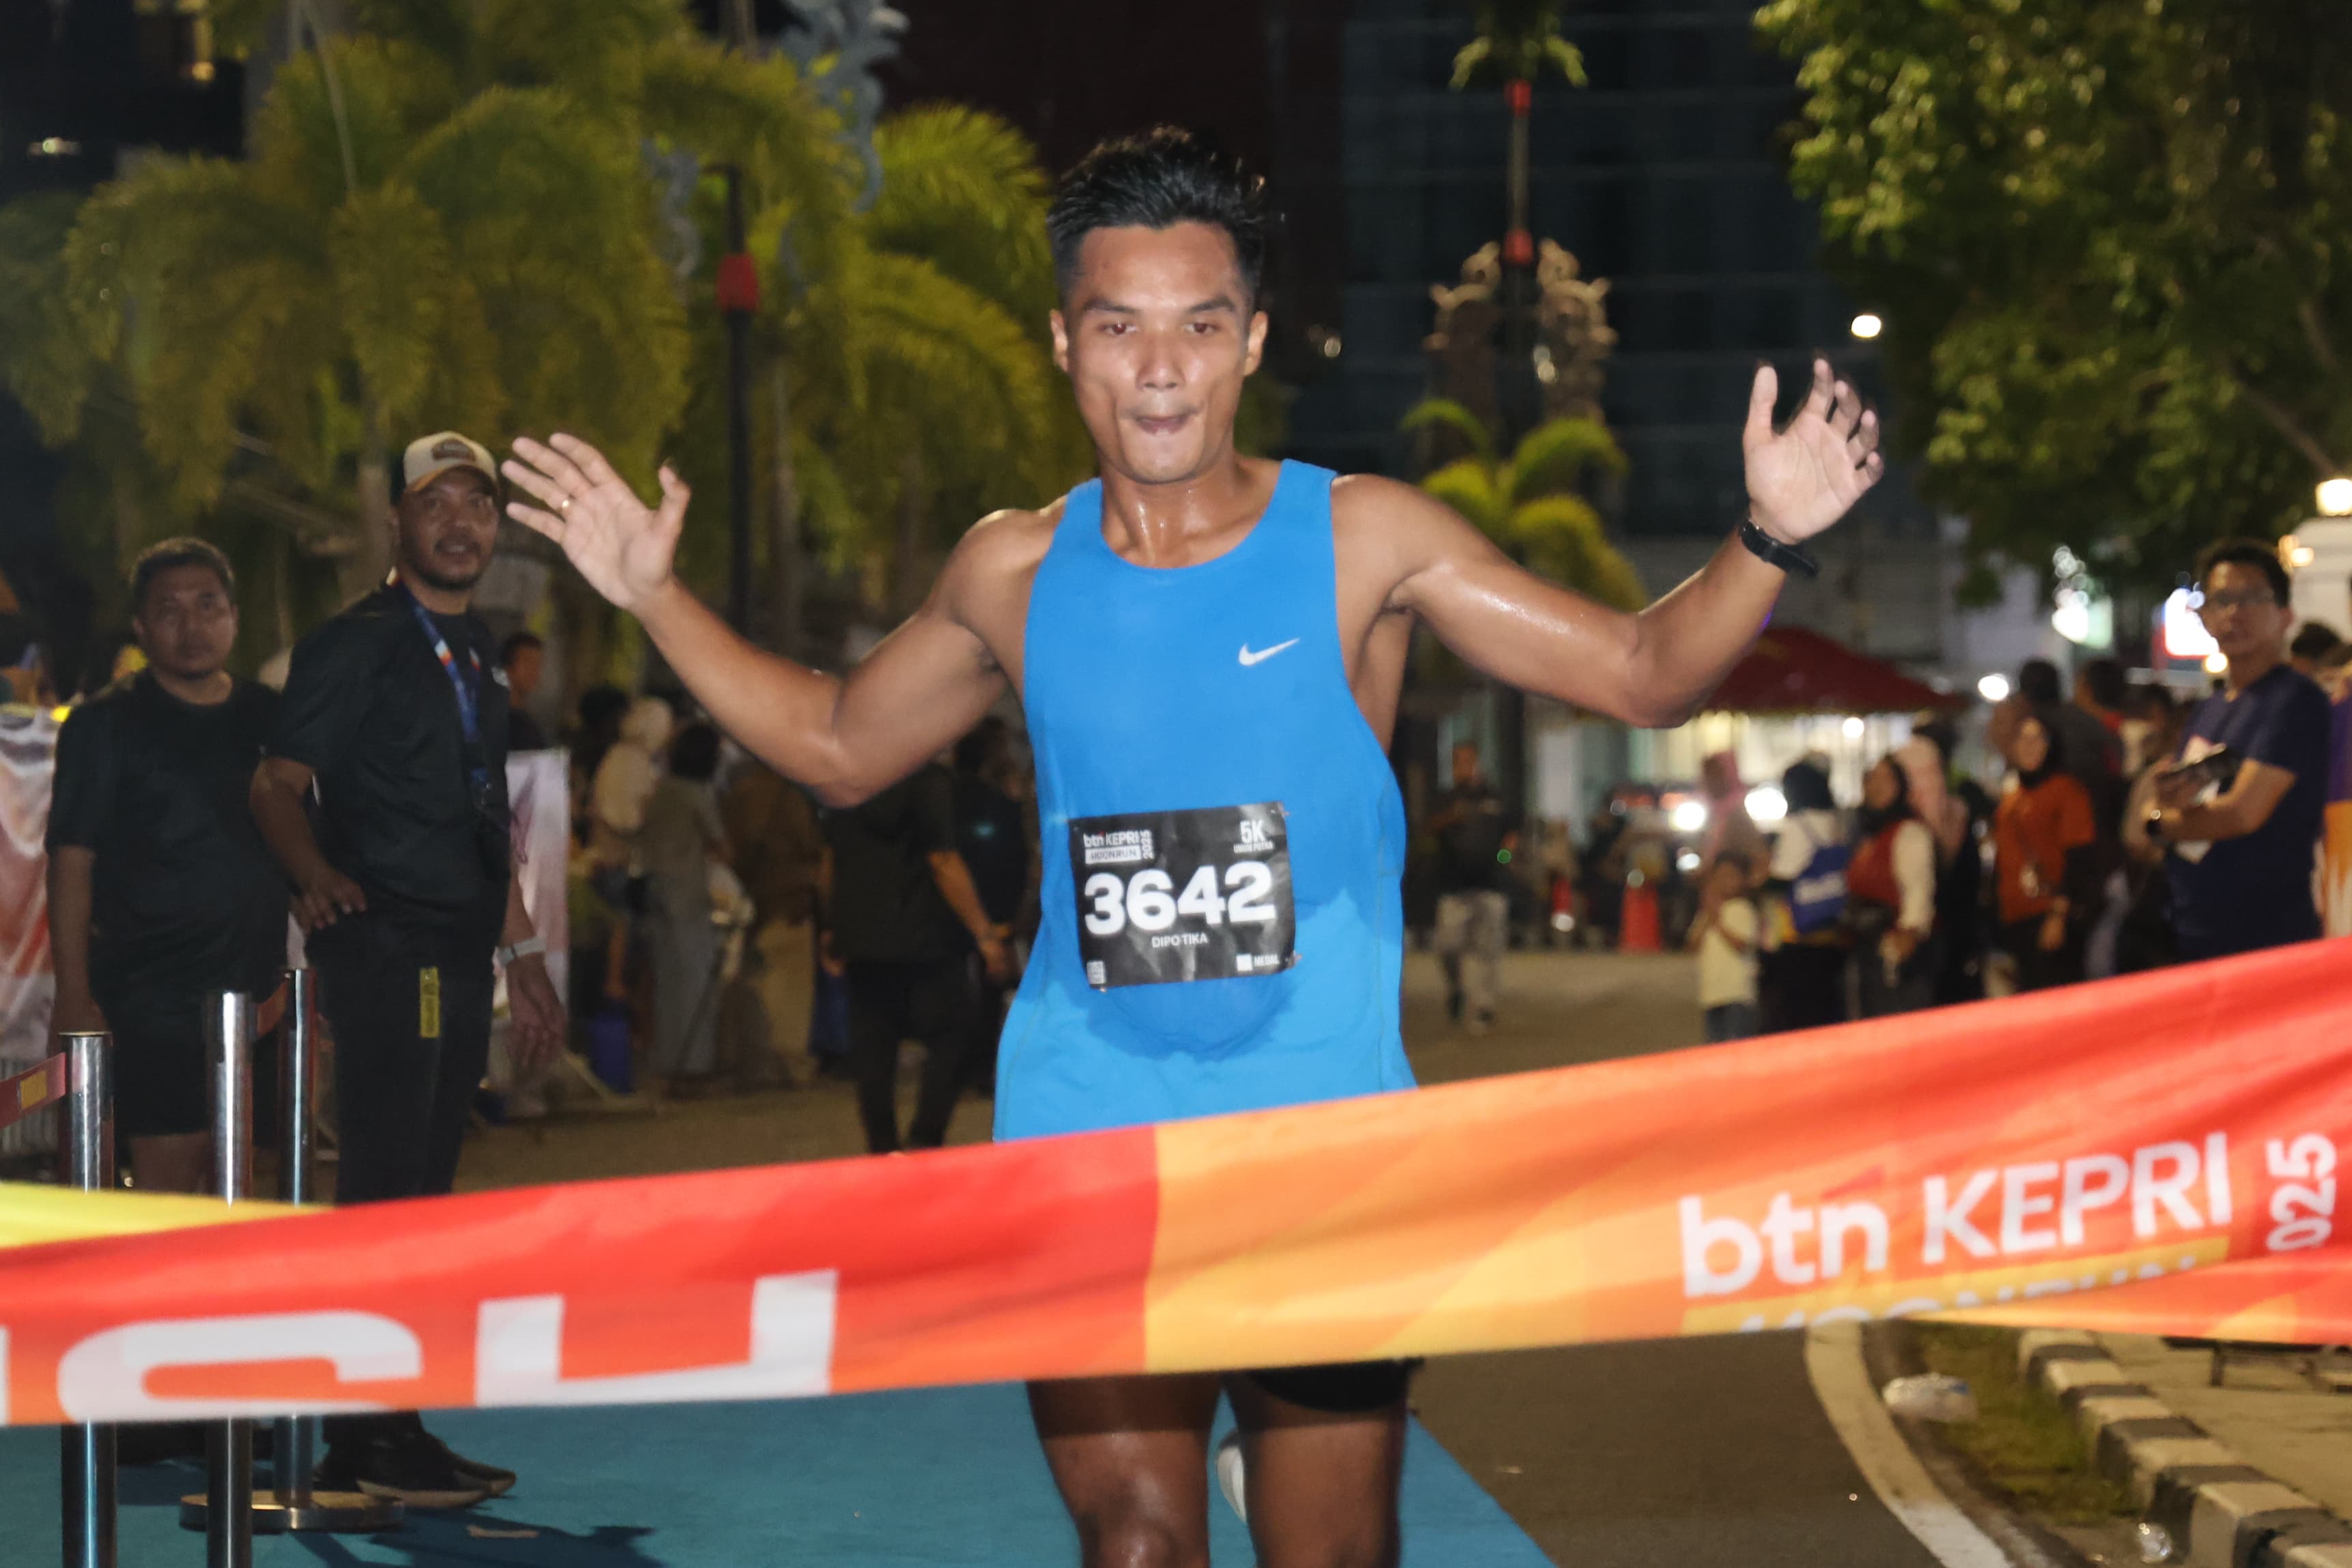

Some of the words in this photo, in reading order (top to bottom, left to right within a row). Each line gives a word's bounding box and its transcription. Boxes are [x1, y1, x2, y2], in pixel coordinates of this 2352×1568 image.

[1106, 830, 1140, 845] KEPRI
[1240, 820, 1265, 843] 5K
[1084, 860, 1276, 936] 3642
[1151, 935, 1179, 948] DIPO
[1181, 932, 1208, 945] TIKA
[1679, 1192, 1889, 1297] btn
[1922, 1132, 2232, 1265] KEPRI
